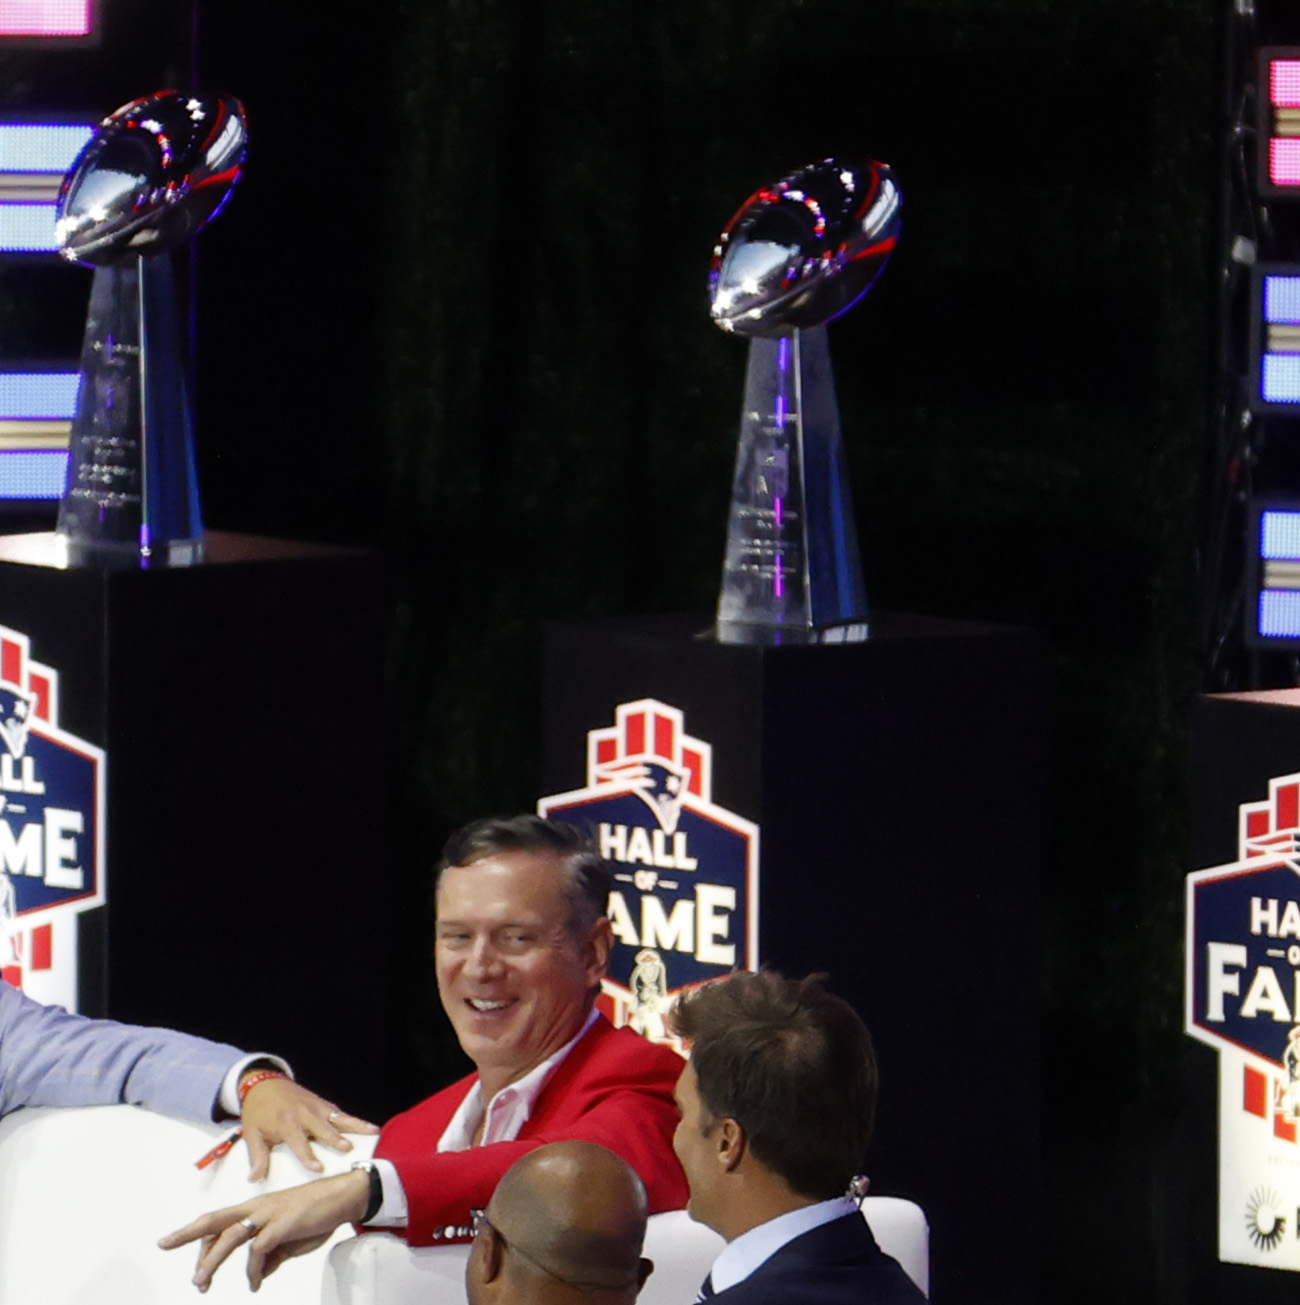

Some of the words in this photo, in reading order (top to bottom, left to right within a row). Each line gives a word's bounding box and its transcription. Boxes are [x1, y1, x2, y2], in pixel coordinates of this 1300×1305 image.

[600, 822, 698, 871] HALL
[633, 869, 658, 891] OF
[606, 882, 736, 966] AME
[1250, 896, 1300, 941] HA
[1206, 941, 1300, 1024] FA
